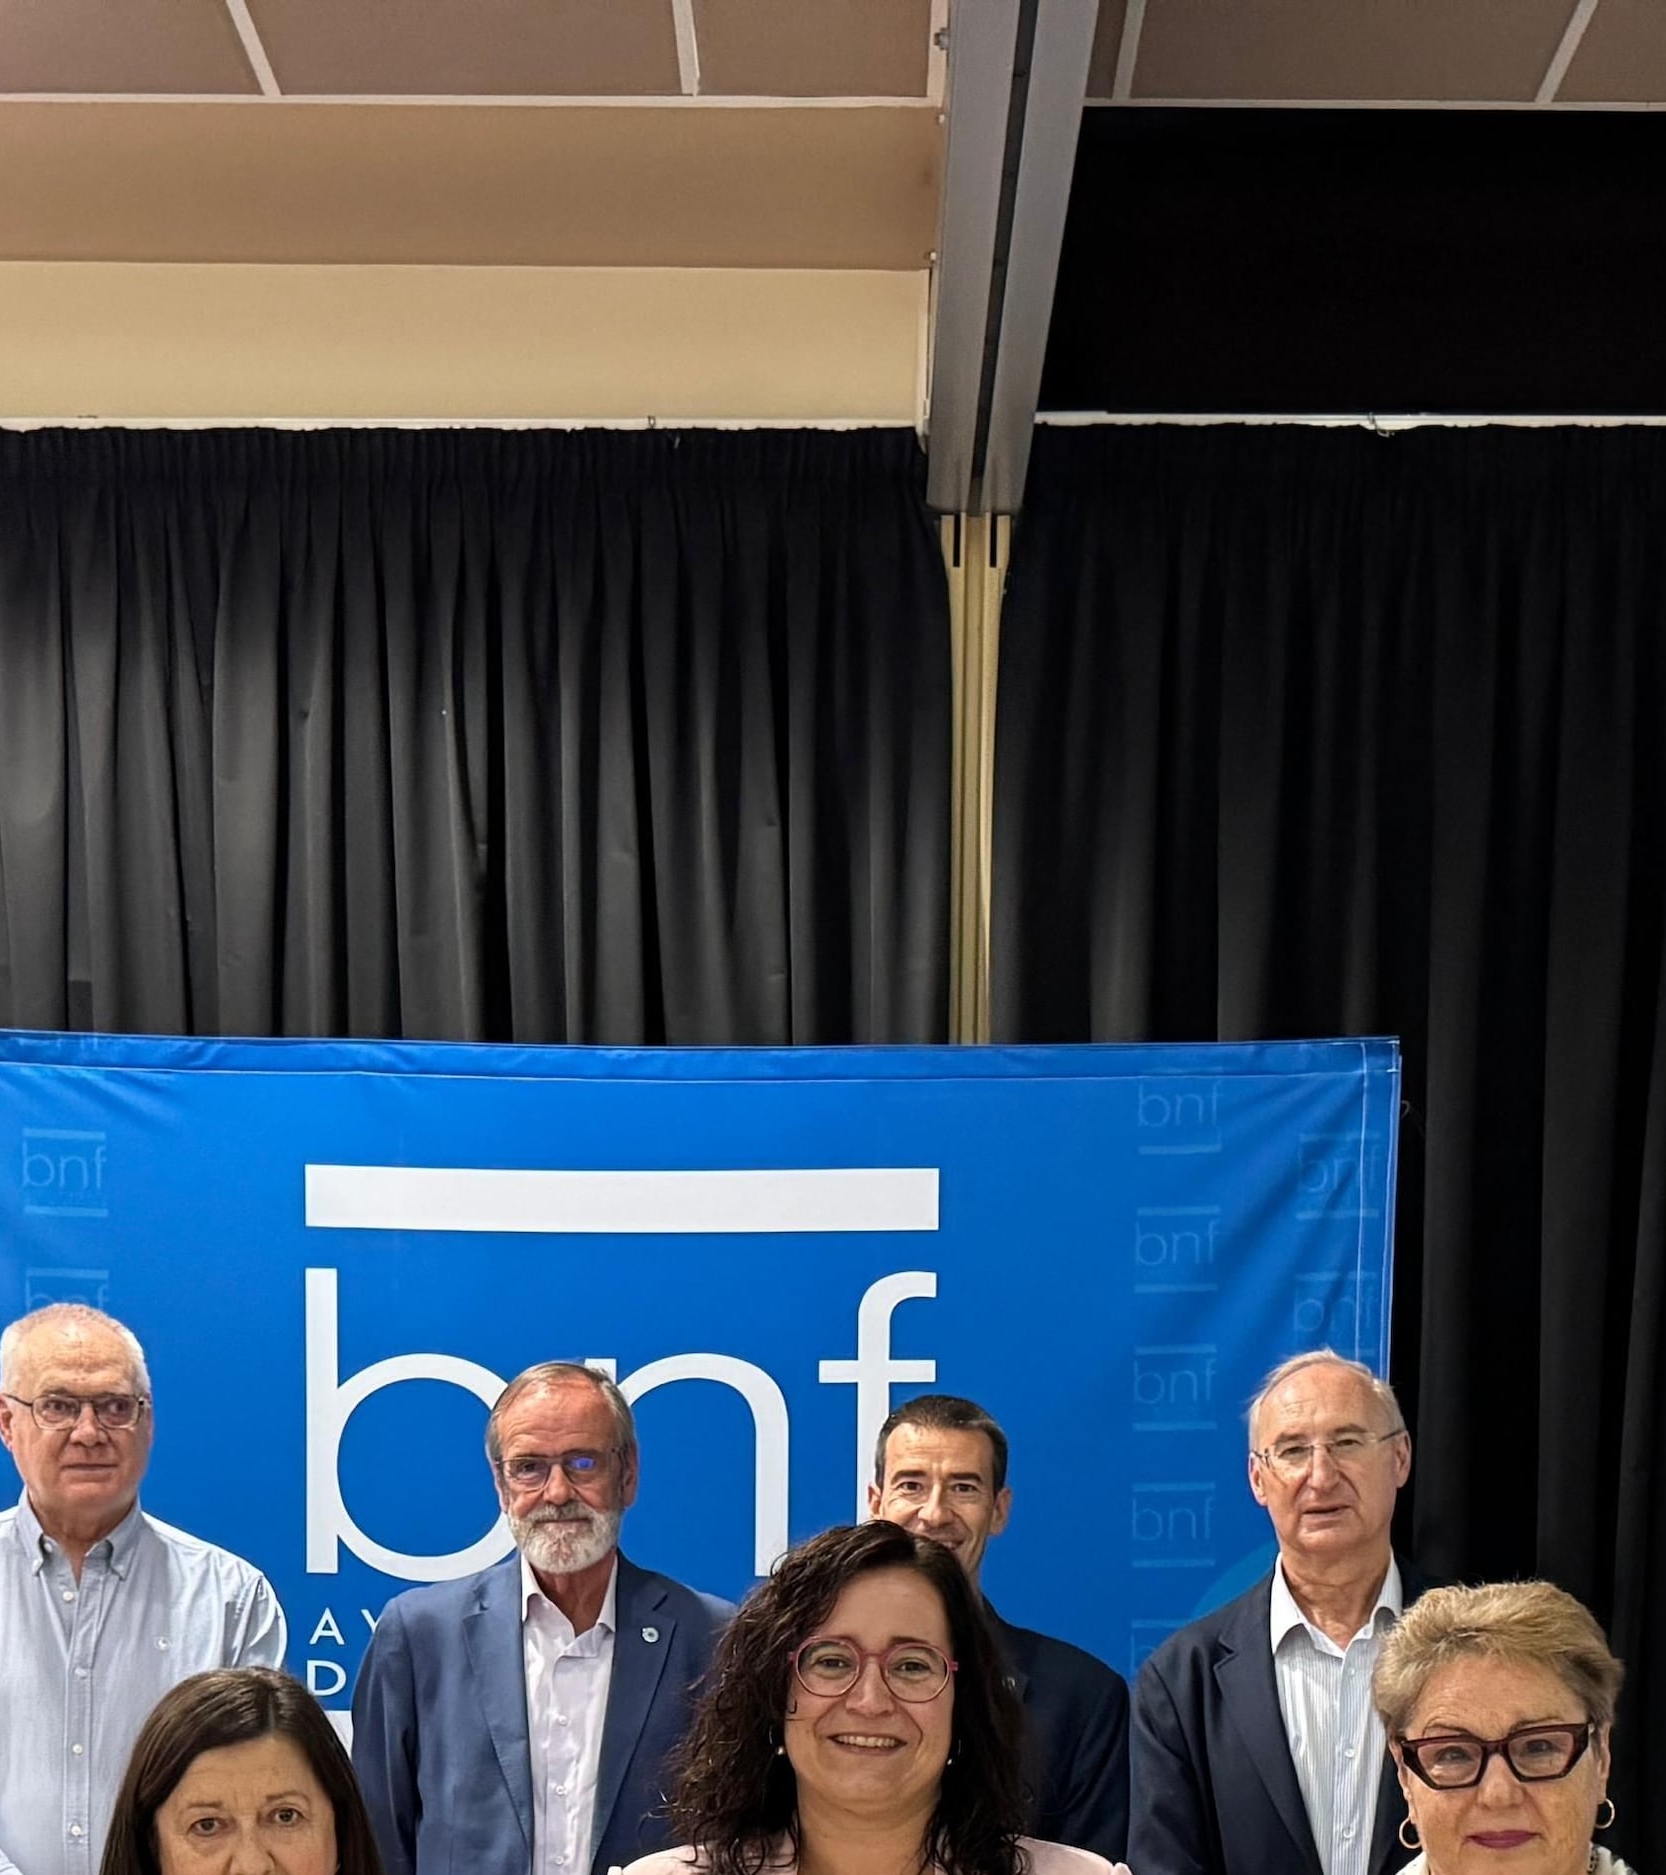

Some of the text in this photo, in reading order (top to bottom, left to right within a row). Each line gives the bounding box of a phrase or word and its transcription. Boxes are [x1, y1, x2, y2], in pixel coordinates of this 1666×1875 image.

[23, 1140, 106, 1190] bnf
[1136, 1221, 1221, 1266] bnf
[1135, 1358, 1216, 1403] bnf
[305, 1266, 937, 1582] bnf
[1134, 1497, 1214, 1541] bnf
